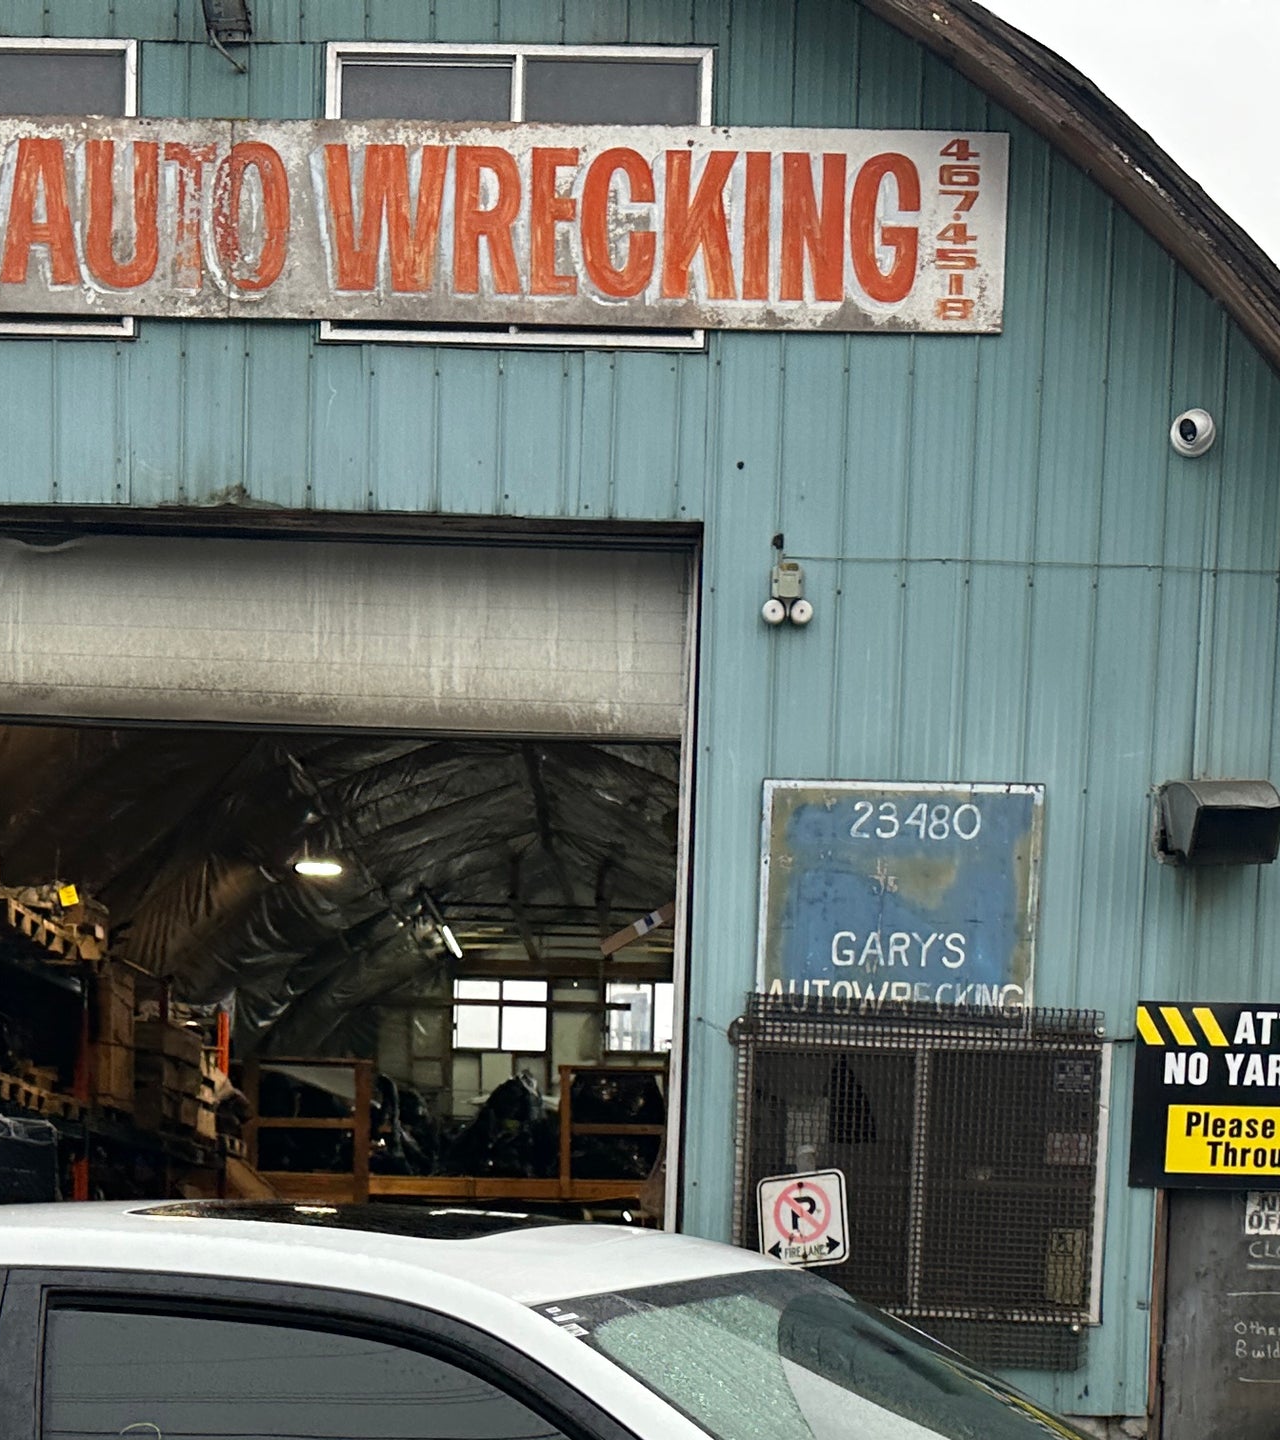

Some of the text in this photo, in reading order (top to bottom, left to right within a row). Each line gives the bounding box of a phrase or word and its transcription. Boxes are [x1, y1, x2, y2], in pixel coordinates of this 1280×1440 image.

[321, 143, 923, 304] WRECKING
[849, 800, 983, 841] 23480
[830, 930, 967, 969] GARY'S
[1163, 1051, 1210, 1086] NO
[1185, 1111, 1276, 1139] Please
[784, 1246, 801, 1259] FIRE
